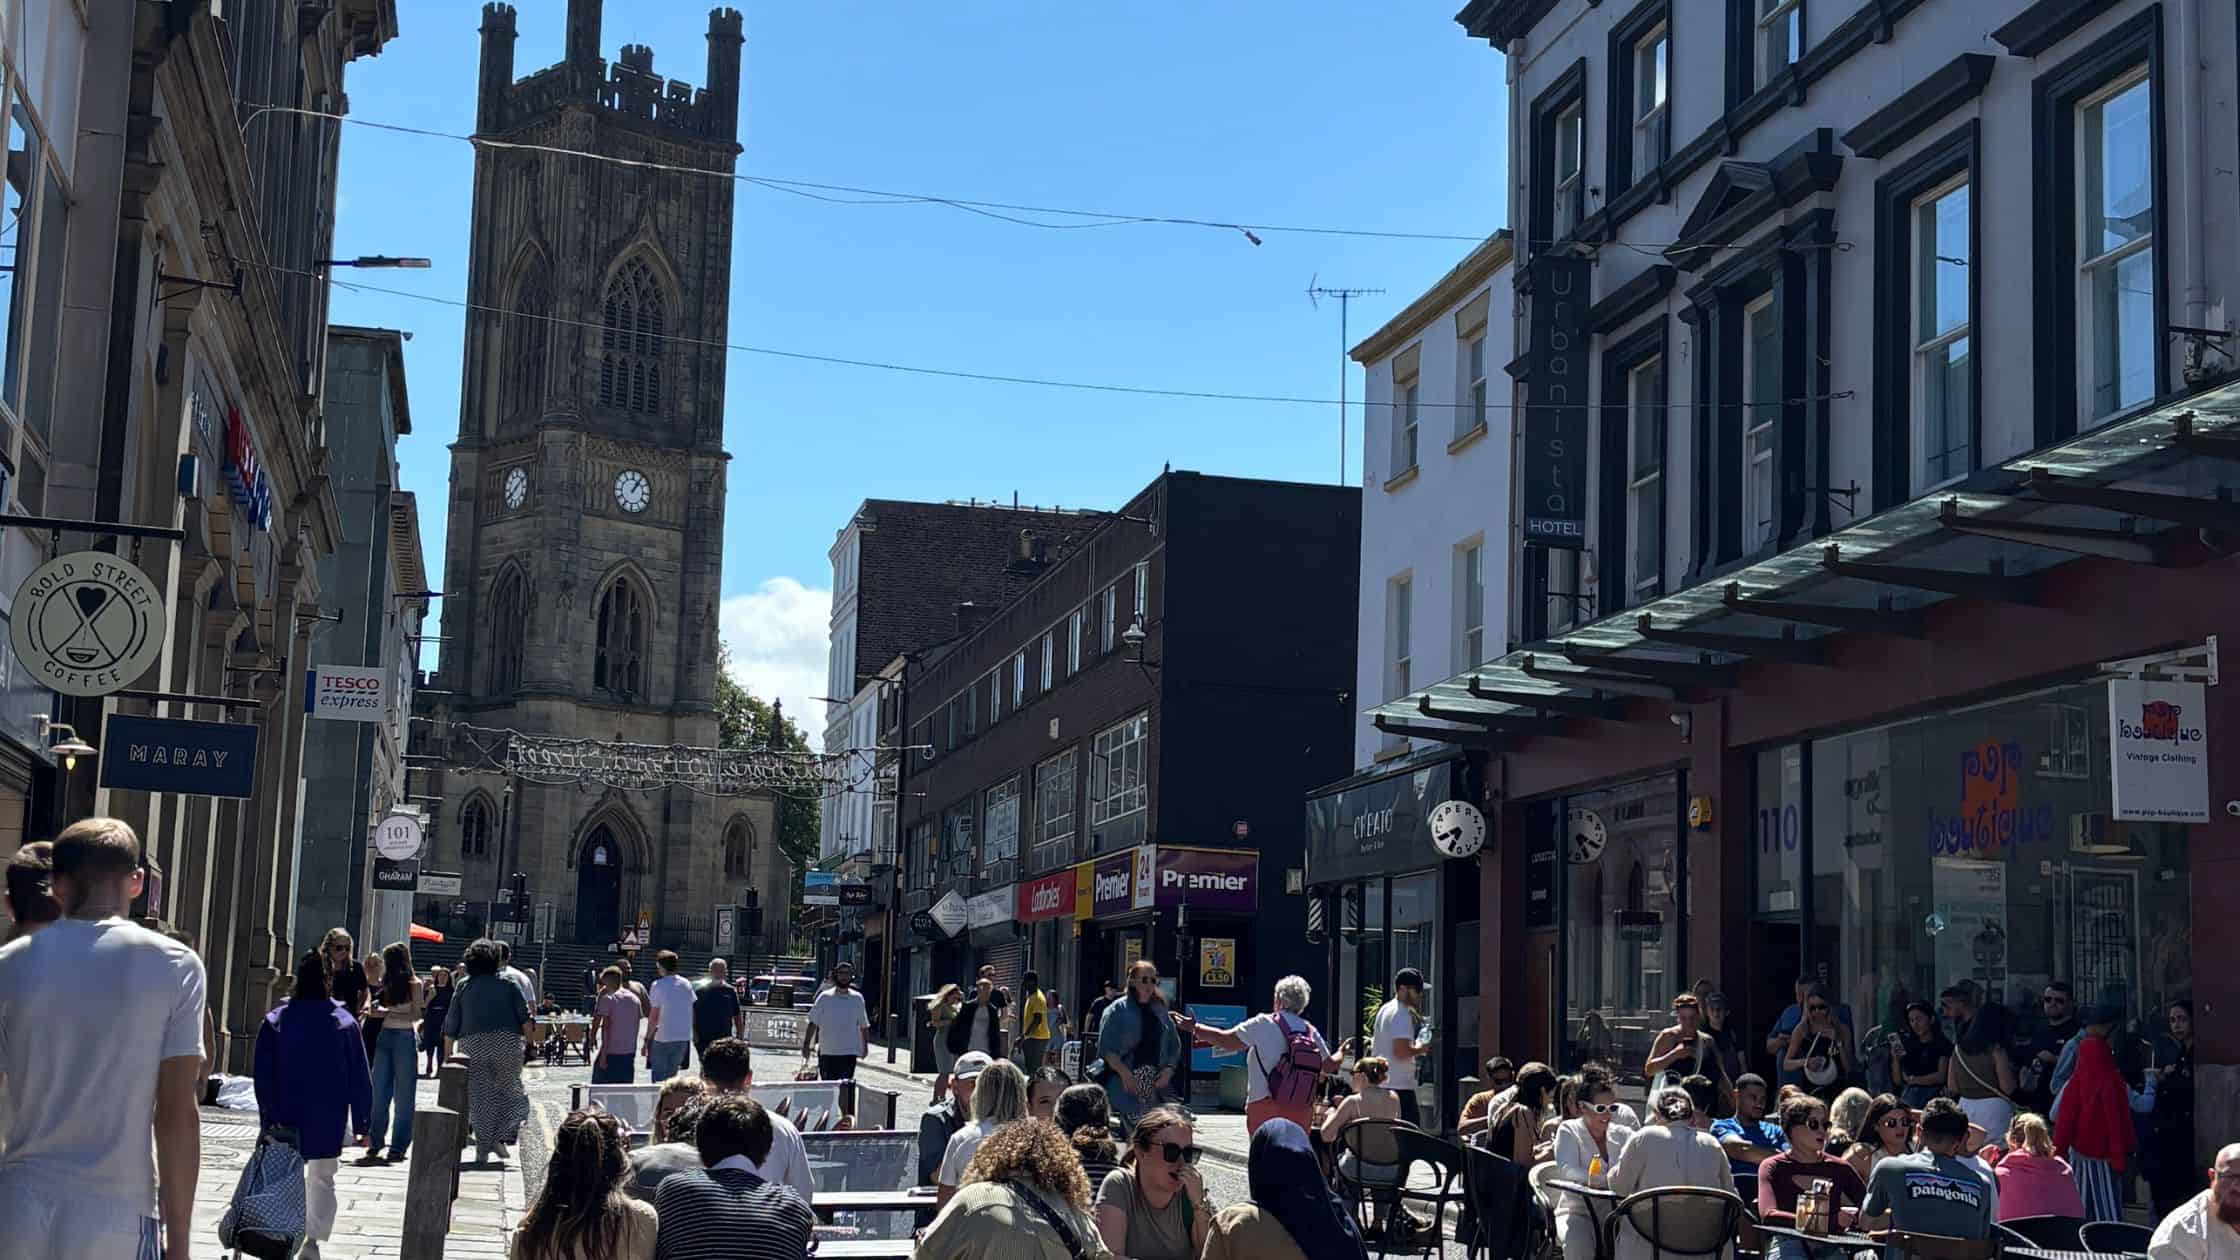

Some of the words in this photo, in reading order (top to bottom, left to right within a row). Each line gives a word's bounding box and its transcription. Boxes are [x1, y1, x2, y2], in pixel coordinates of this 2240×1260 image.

[1546, 268, 1573, 513] Urbanista
[1529, 518, 1583, 536] HOTEL
[30, 563, 74, 598] BOLD
[92, 562, 152, 606] STREET
[43, 660, 121, 688] COFFEE
[322, 675, 380, 690] TESCO
[320, 694, 379, 709] express
[128, 743, 229, 768] MARAY
[2126, 752, 2160, 763] Vintage
[2162, 753, 2198, 765] Clothing
[388, 826, 410, 840] 101
[1759, 804, 1799, 854] 110
[1095, 871, 1130, 903] Premier
[1162, 869, 1248, 892] Premier
[1911, 1185, 1979, 1208] patagonia
